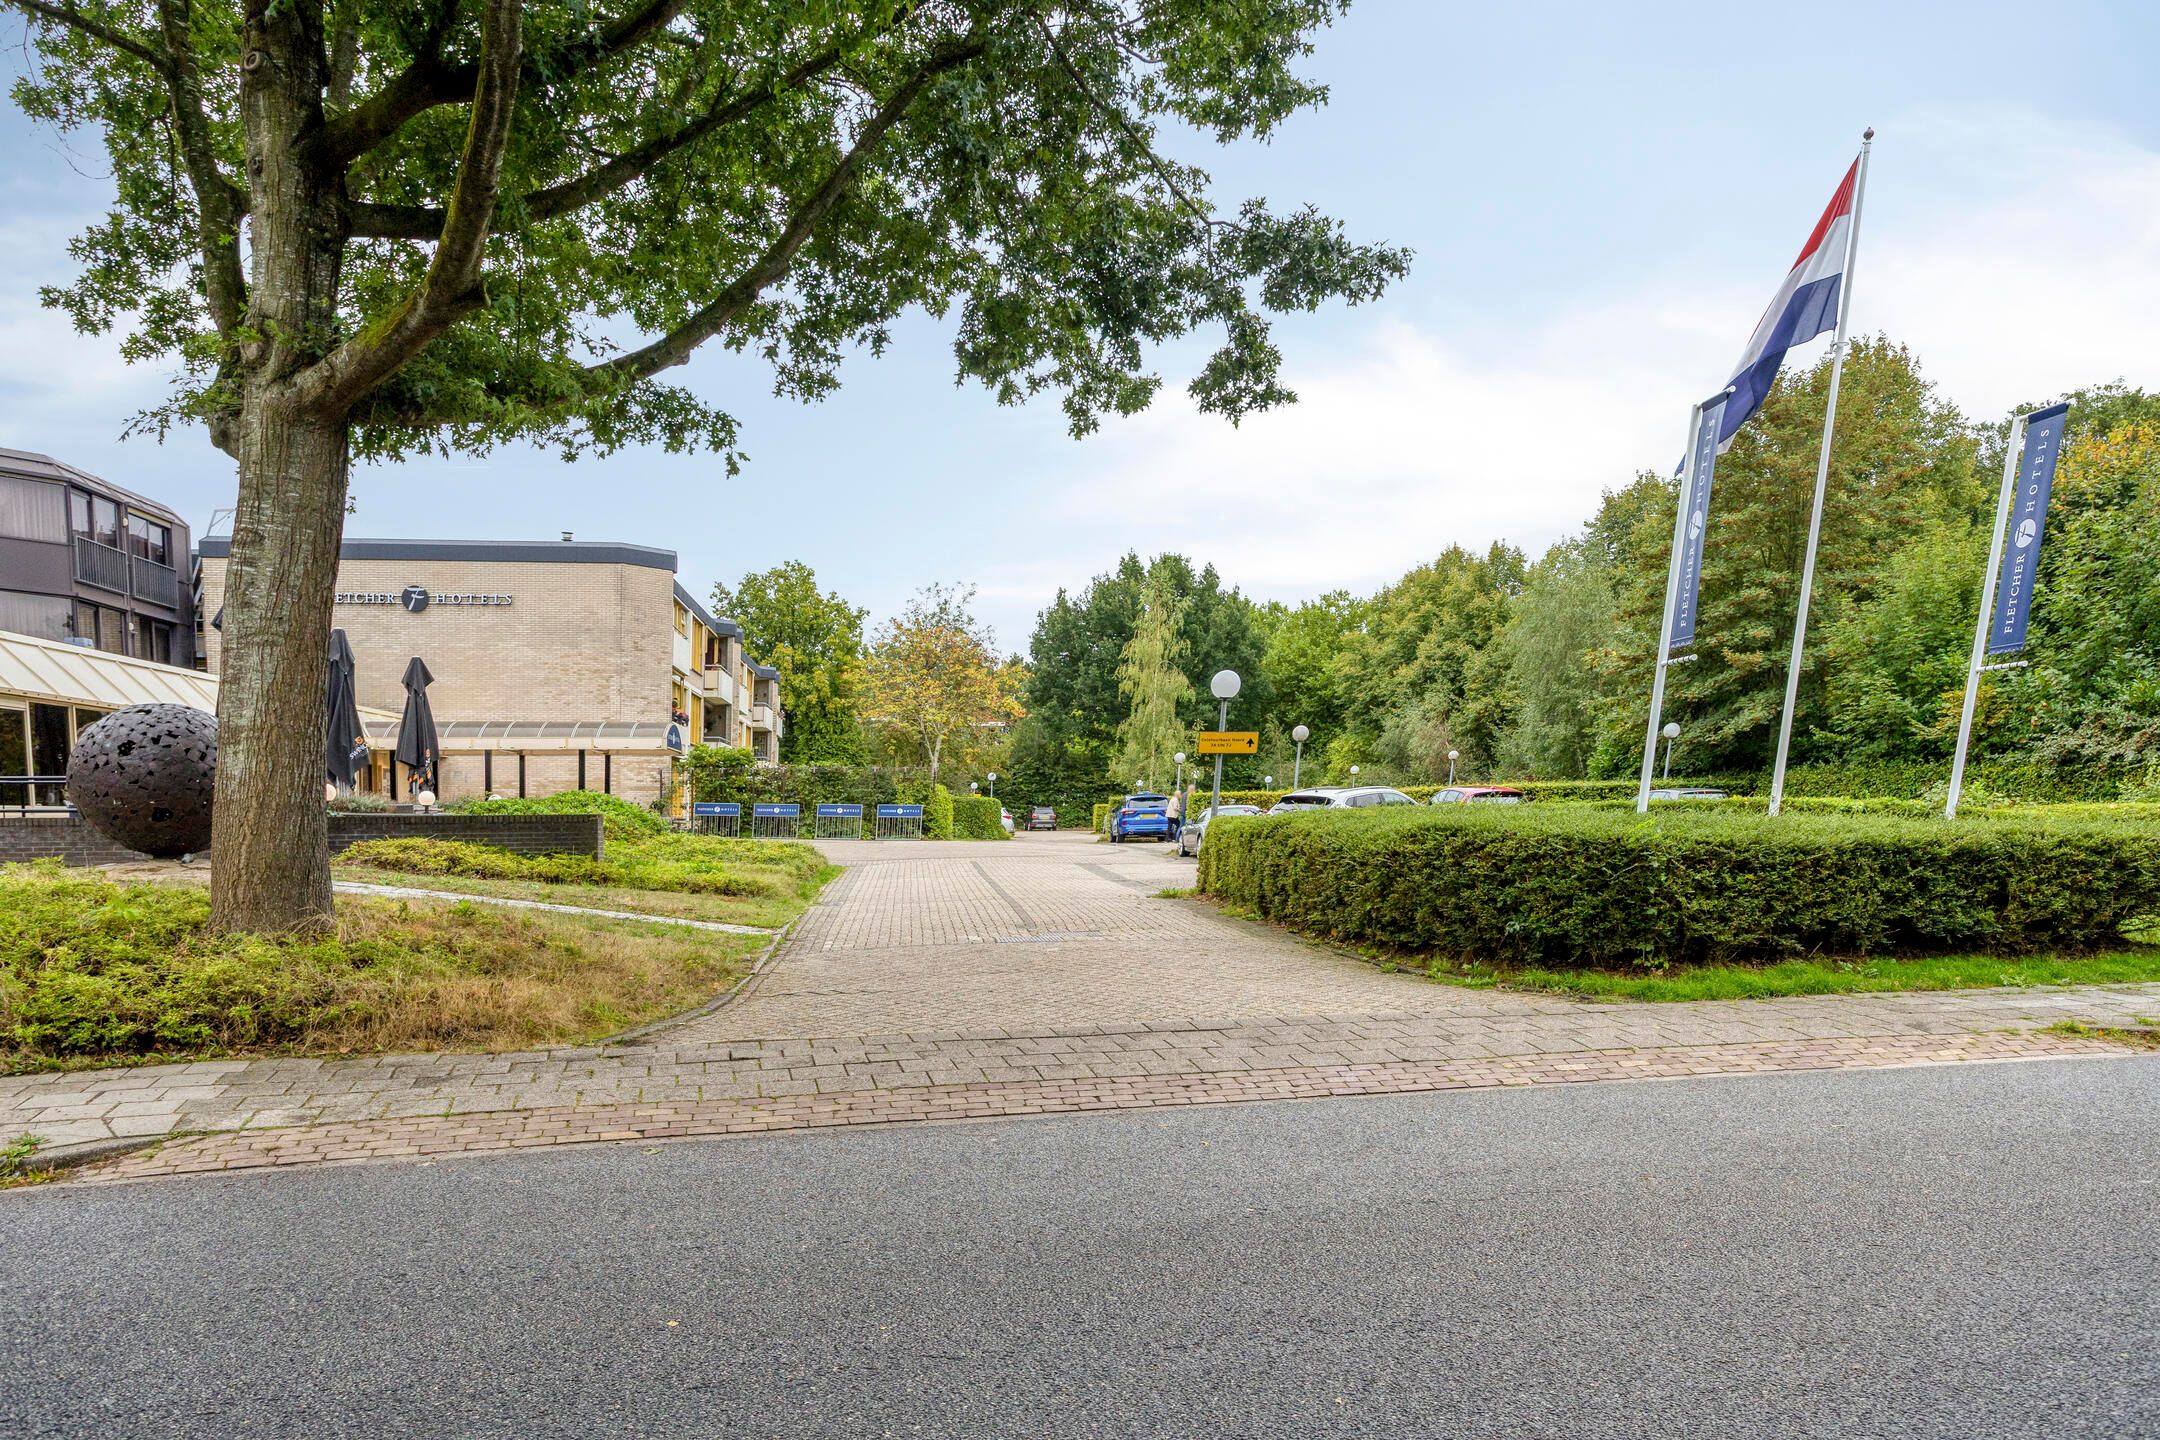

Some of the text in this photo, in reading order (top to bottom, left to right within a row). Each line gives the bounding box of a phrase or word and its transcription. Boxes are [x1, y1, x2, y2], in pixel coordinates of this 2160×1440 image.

[335, 592, 513, 605] ETCHER HOTELS
[1680, 419, 1715, 628] FLETCHER HOTELS
[2004, 429, 2050, 634] FLETCHER HOTELS
